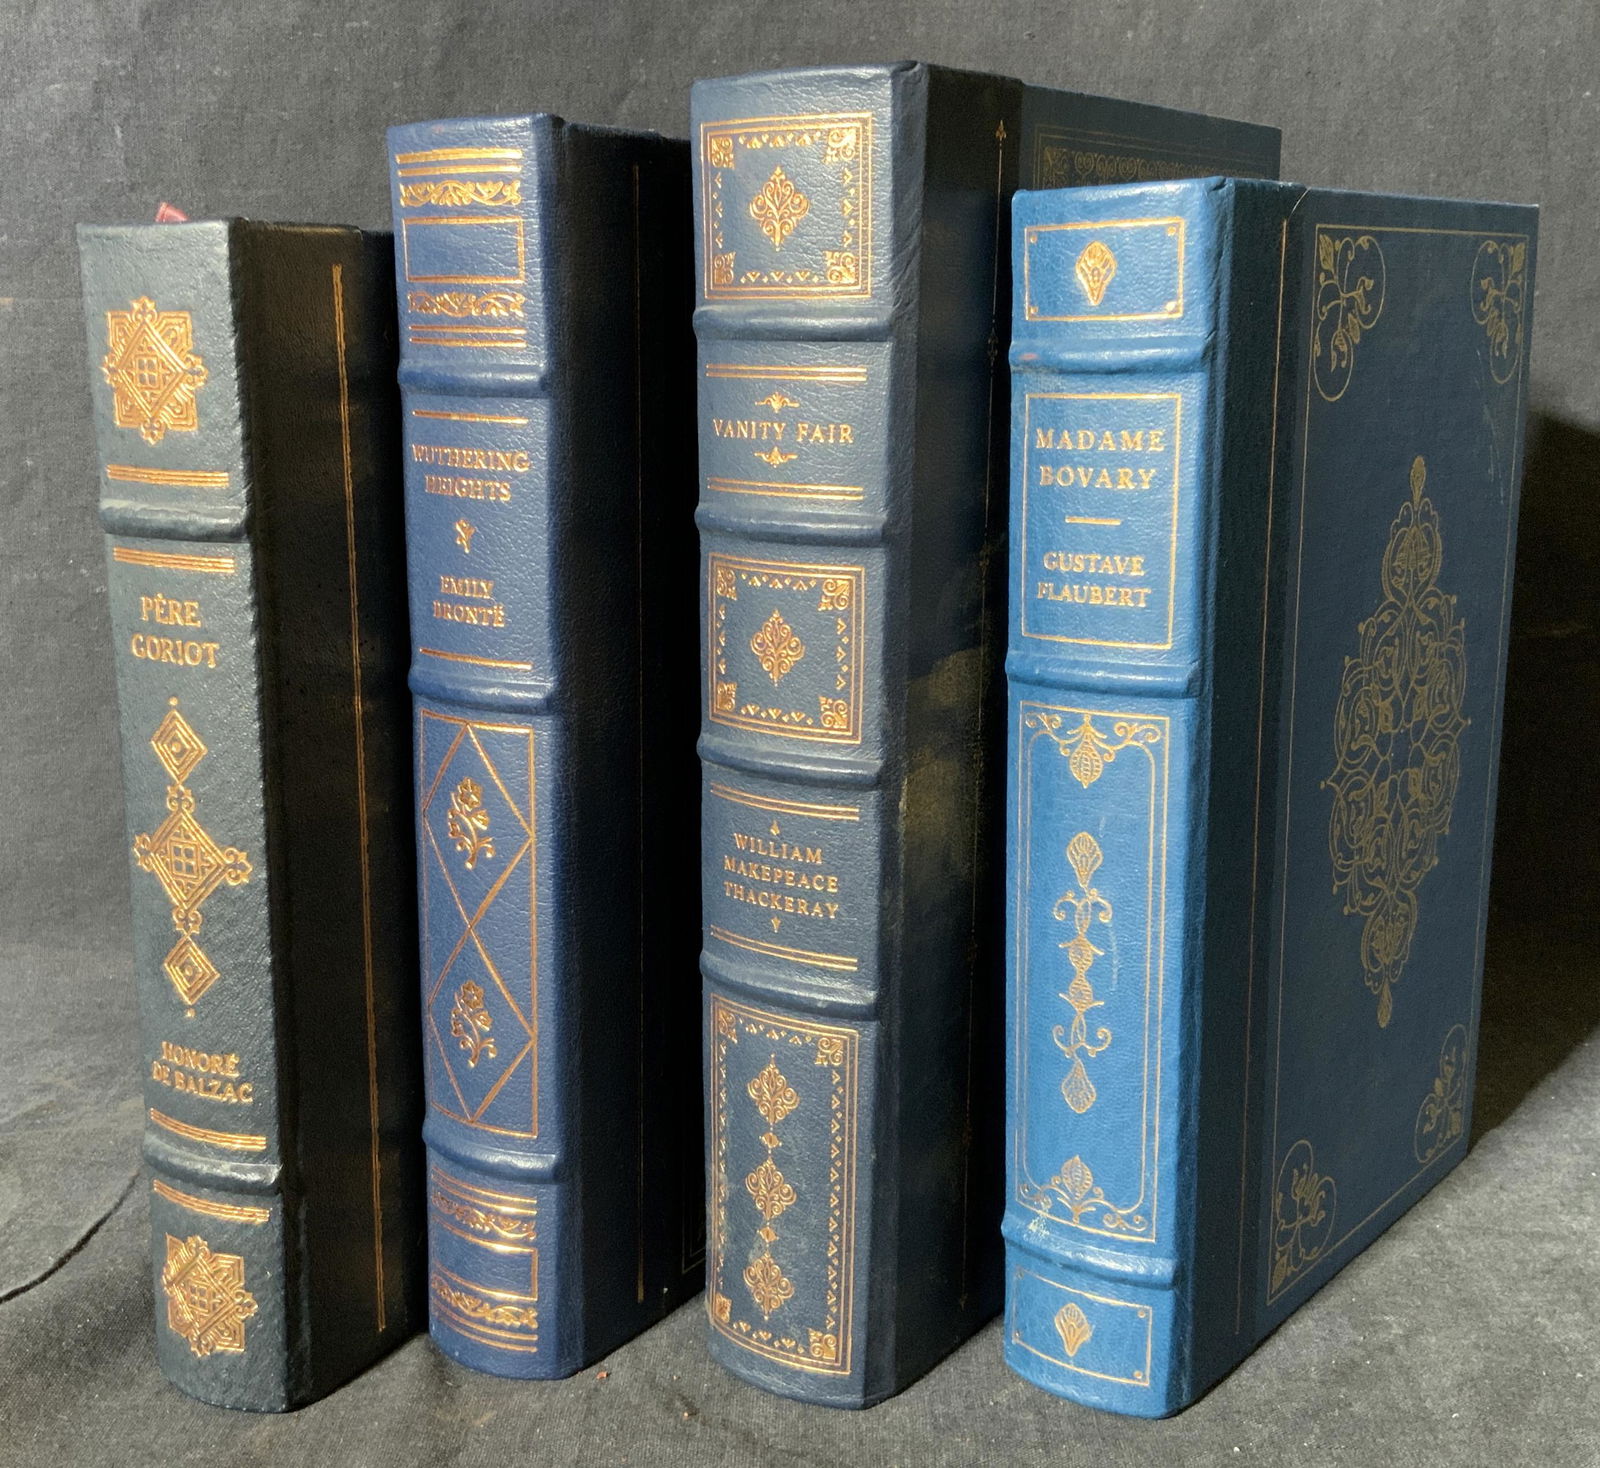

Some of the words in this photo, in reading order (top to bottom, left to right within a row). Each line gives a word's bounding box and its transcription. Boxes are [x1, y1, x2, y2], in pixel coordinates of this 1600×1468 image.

[712, 418, 786, 441] VANITY
[796, 421, 854, 444] FAIR
[1036, 427, 1166, 452] MADAME
[411, 442, 531, 473] WUTHERING
[424, 474, 512, 502] HEIGHTS
[1039, 464, 1157, 491] BOVARY
[1042, 551, 1146, 577] GUSTAVE
[440, 575, 495, 600] EMILY
[1036, 581, 1153, 608] FLAUBERT
[130, 632, 220, 670] GORIOT
[733, 832, 823, 865] WILLIAM
[723, 854, 839, 893] MAKEPEACE
[723, 880, 839, 919] THACKERAY
[174, 1070, 254, 1104] BALZAC
